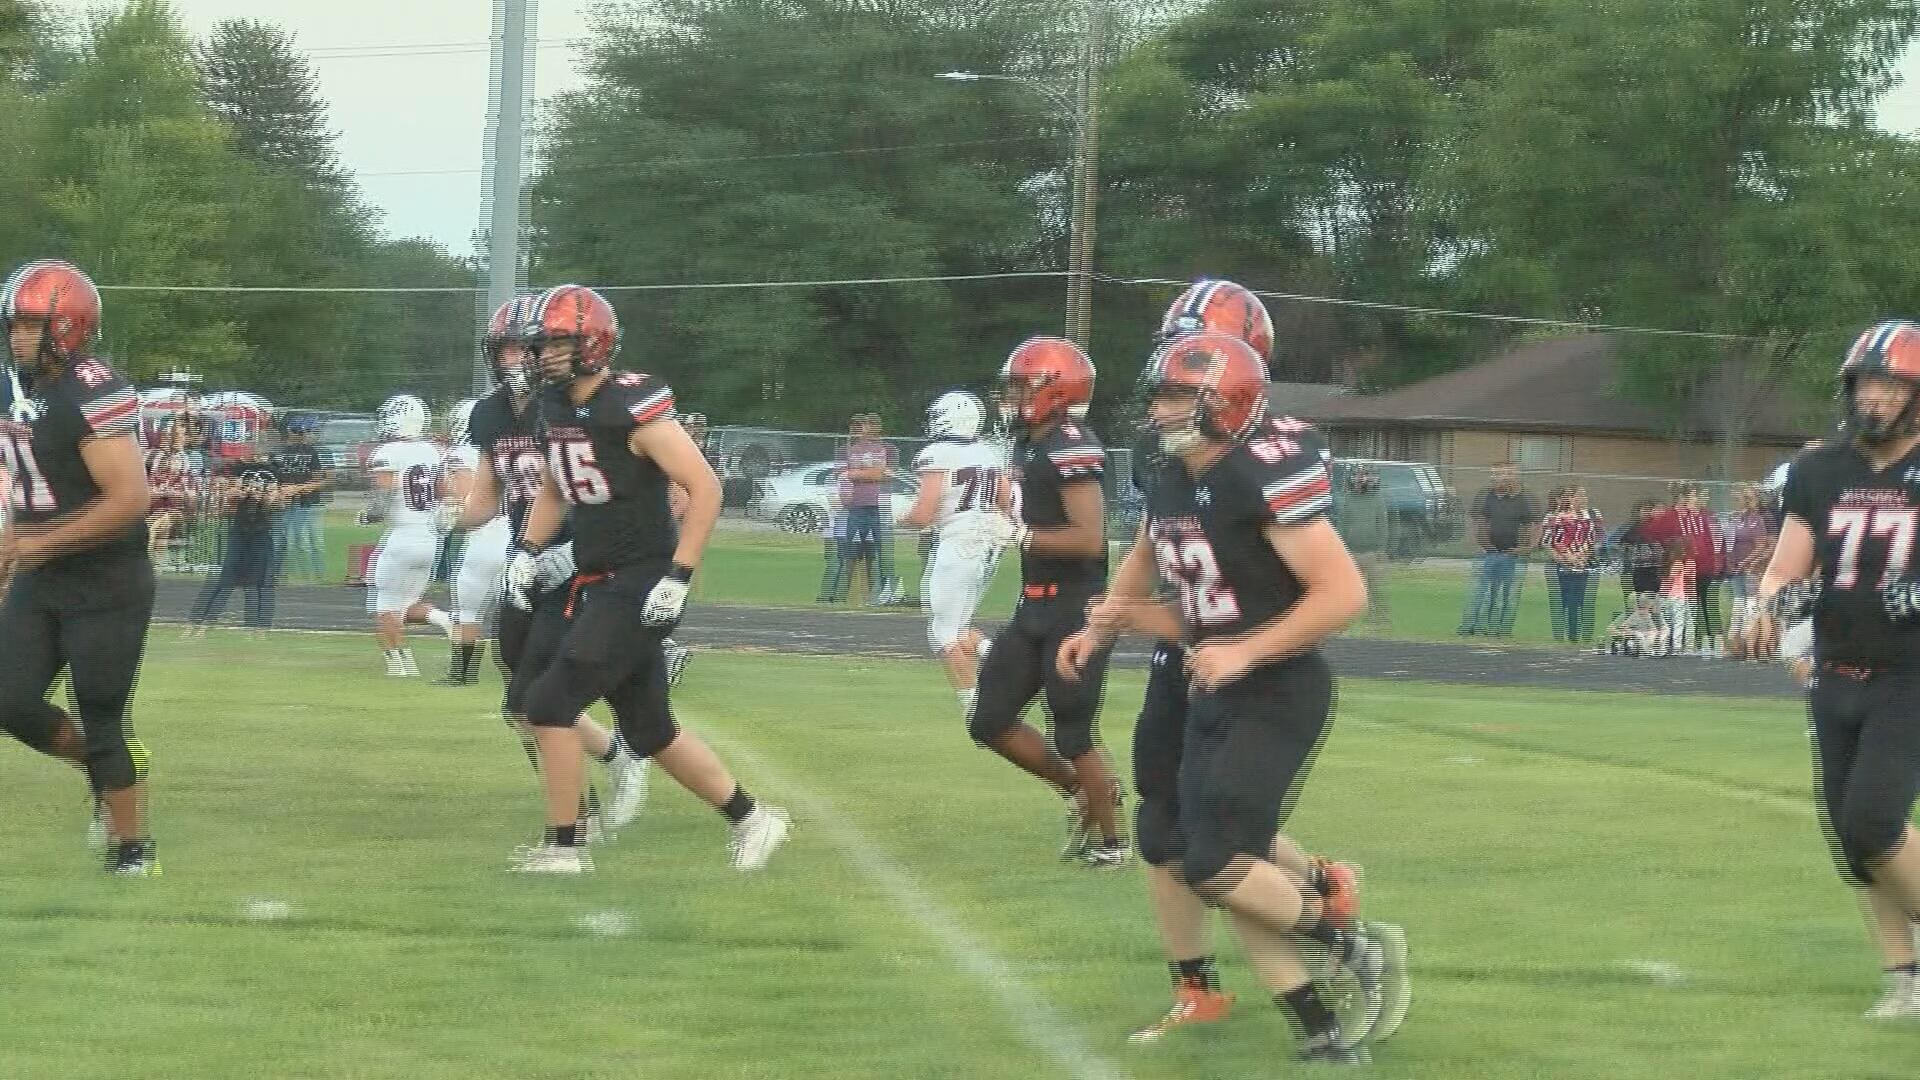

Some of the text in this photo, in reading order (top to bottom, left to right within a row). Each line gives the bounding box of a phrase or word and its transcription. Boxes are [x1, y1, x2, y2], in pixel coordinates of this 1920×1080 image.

[952, 465, 1001, 514] 70
[1838, 487, 1909, 508] MITCHELL
[1156, 534, 1242, 627] 62
[1827, 504, 1919, 591] 77
